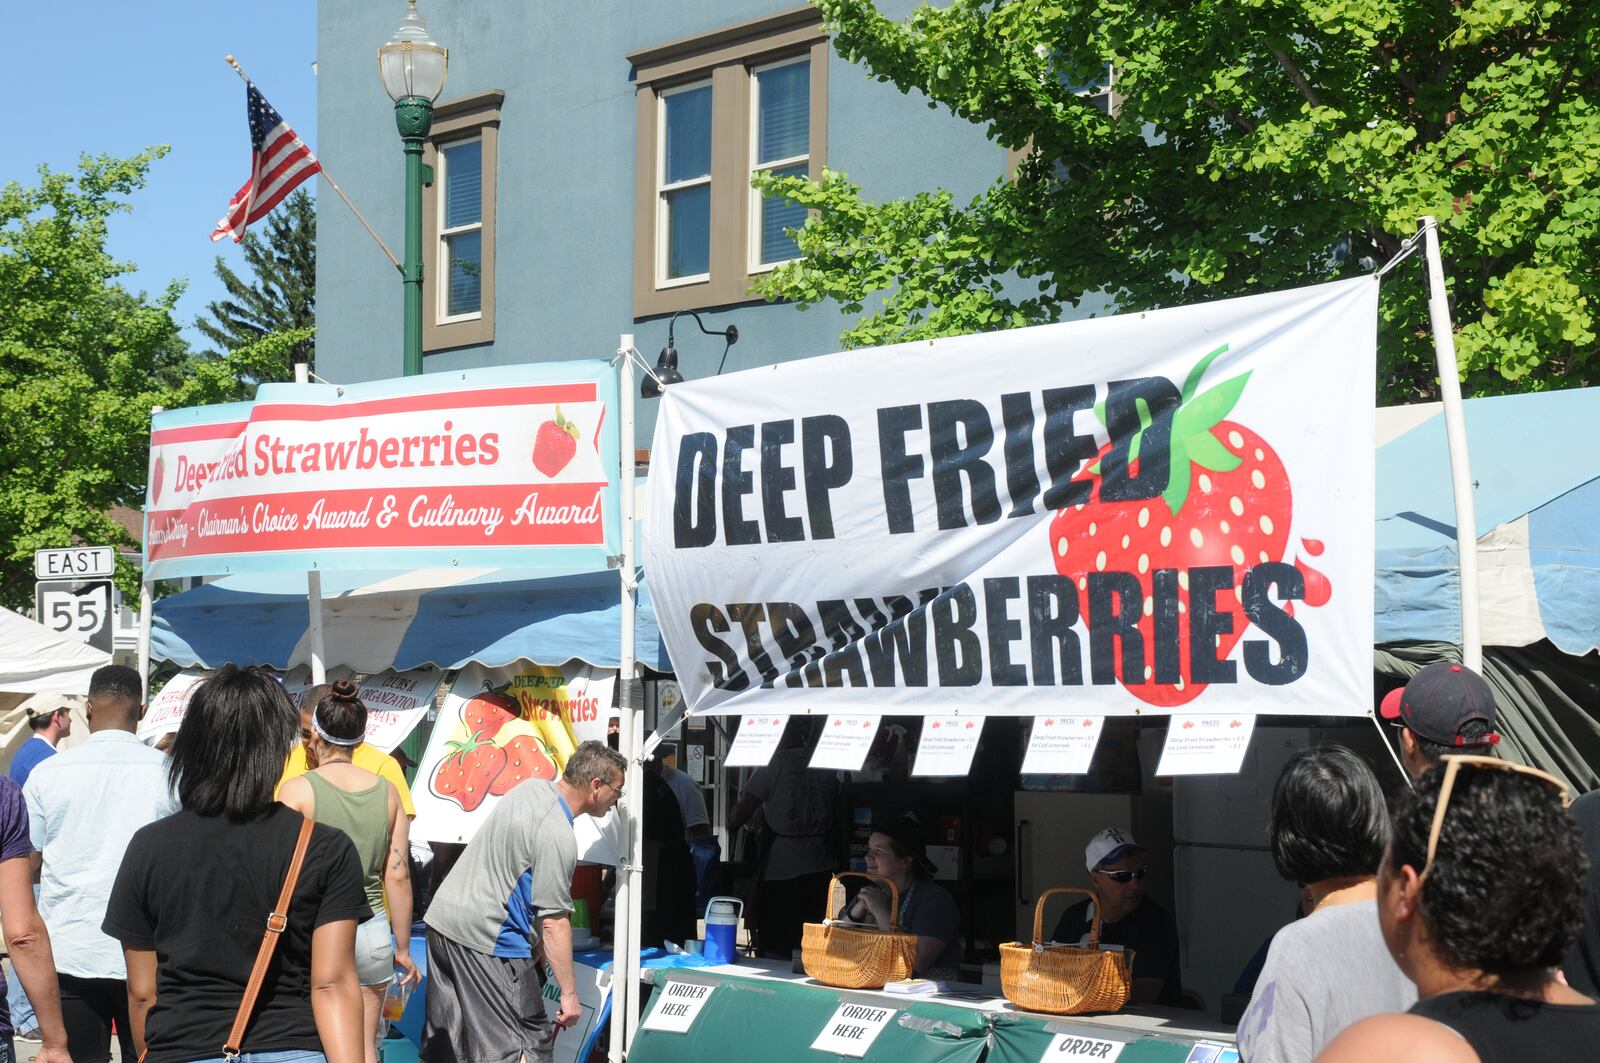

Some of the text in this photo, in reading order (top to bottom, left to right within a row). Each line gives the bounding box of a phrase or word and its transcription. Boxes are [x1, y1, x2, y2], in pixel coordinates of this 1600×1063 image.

[254, 420, 499, 477] Strawberries
[673, 376, 1182, 549] DEEP FRIED
[198, 505, 249, 538] Chairman's
[252, 502, 299, 534] Choice
[303, 497, 374, 531] Award
[375, 494, 399, 531] &
[407, 494, 505, 536] Culinary
[510, 491, 601, 527] Award
[48, 551, 101, 574] EAST
[52, 600, 98, 633] 55
[688, 562, 1309, 691] STRAWBERRIES
[667, 983, 708, 999] ORDER
[660, 1002, 692, 1018] HERE
[841, 1005, 887, 1023] ORDER
[832, 1023, 869, 1040] HERE
[1059, 1037, 1113, 1060] ORDER
